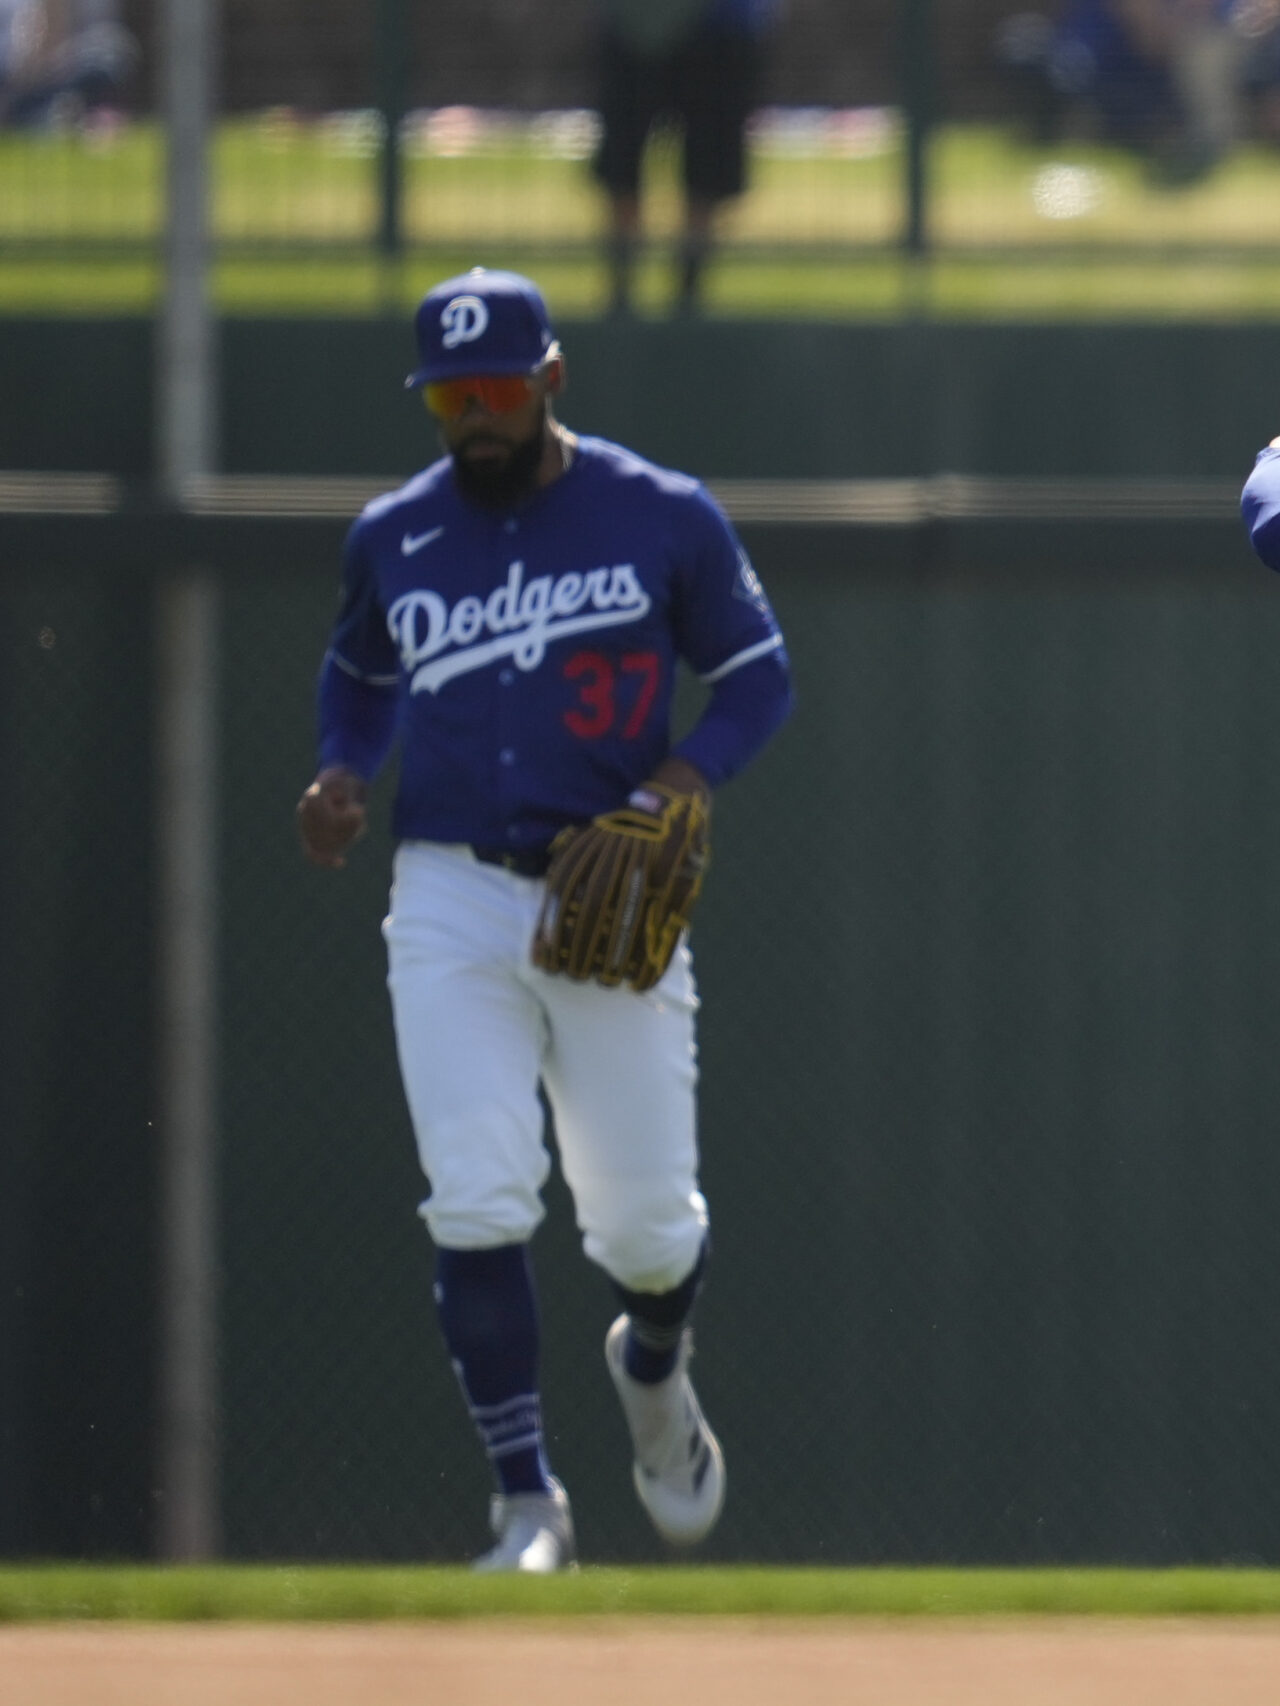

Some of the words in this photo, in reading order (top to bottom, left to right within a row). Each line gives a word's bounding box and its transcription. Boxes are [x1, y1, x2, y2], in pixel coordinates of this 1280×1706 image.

[440, 294, 489, 349] D
[387, 560, 651, 692] Dodgers
[564, 651, 659, 740] 37
